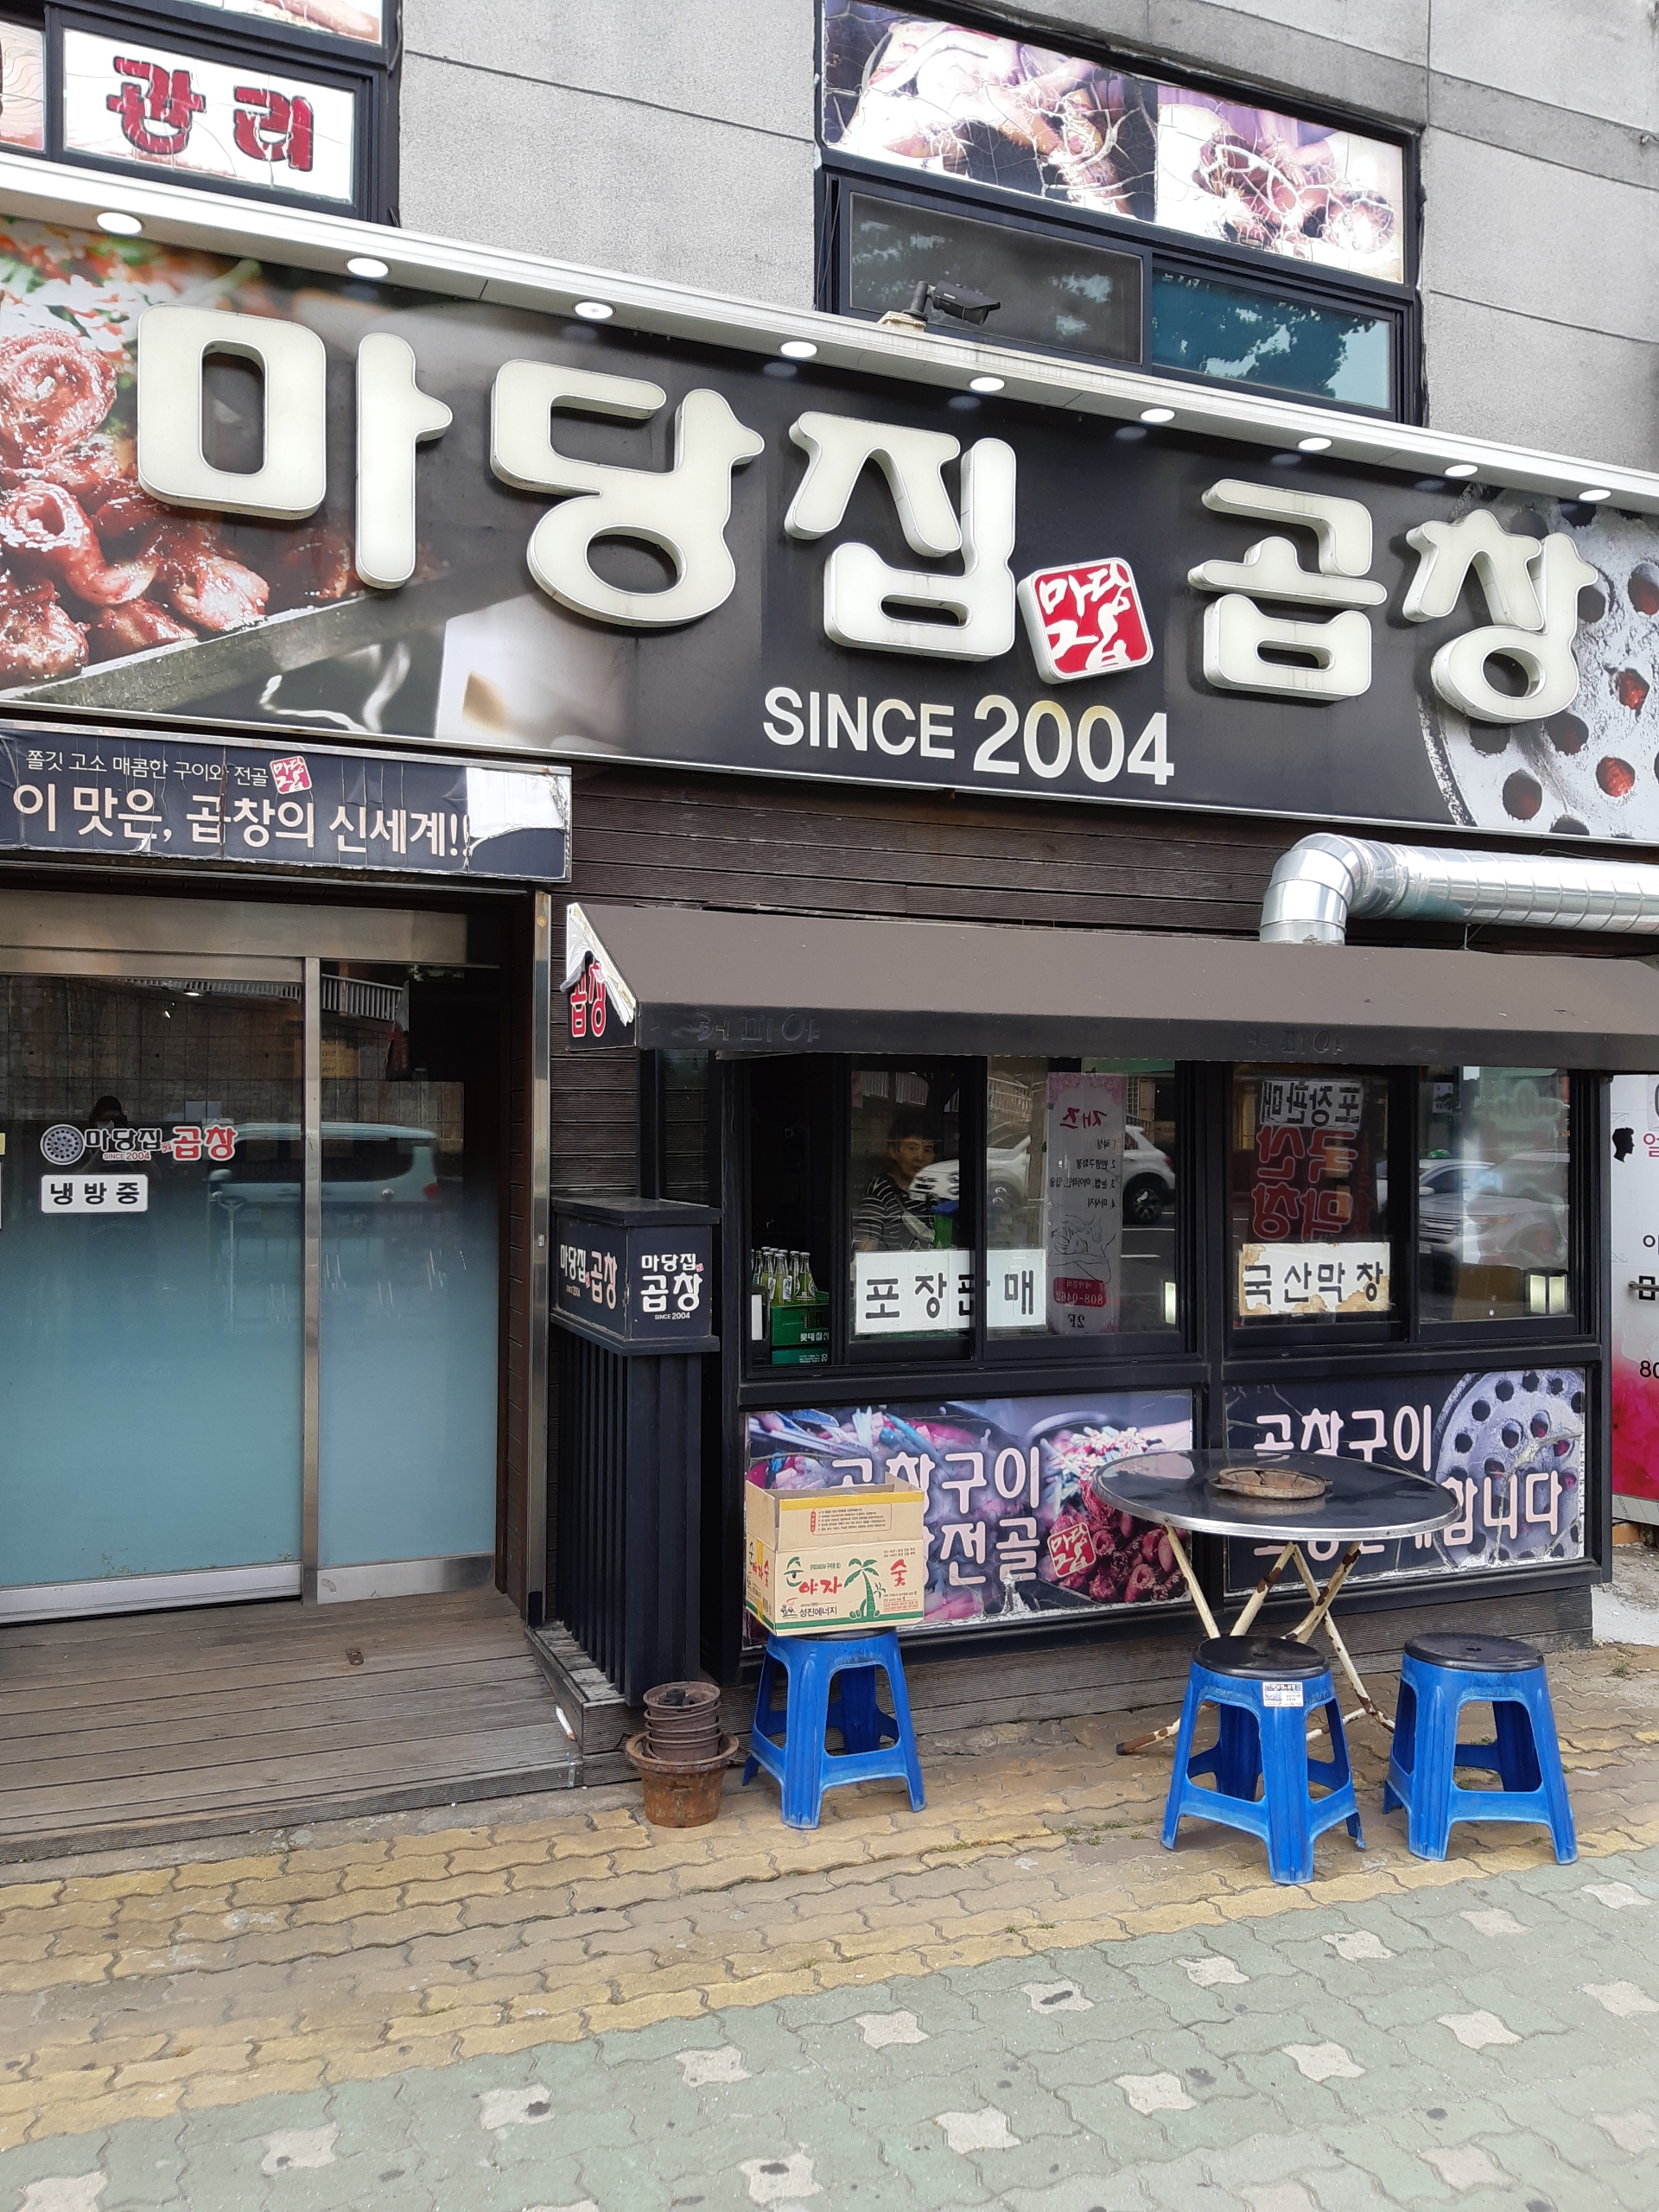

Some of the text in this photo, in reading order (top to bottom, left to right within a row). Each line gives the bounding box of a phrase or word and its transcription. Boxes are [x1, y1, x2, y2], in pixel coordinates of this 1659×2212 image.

[137, 303, 1599, 723] 마당집 곱창
[763, 686, 1174, 785] SINCE 2004
[26, 749, 270, 787] 쫄깃 고소 매콤한 구이와 전골
[13, 784, 55, 832] 이
[73, 786, 172, 843] 맛은,
[187, 794, 315, 849] 곱창의
[86, 1126, 238, 1160] 마당집 곱창
[126, 1152, 151, 1160] 2004
[50, 1182, 141, 1205] 냉방중
[560, 1244, 618, 1310] 마당집 곱창
[641, 1253, 696, 1272] 마당집
[640, 1271, 703, 1313] 곱창
[1243, 1261, 1383, 1306] 국산막창
[671, 1312, 690, 1320] 2004
[798, 1576, 843, 1595] 야자
[799, 1605, 837, 1618] 성진에너지
